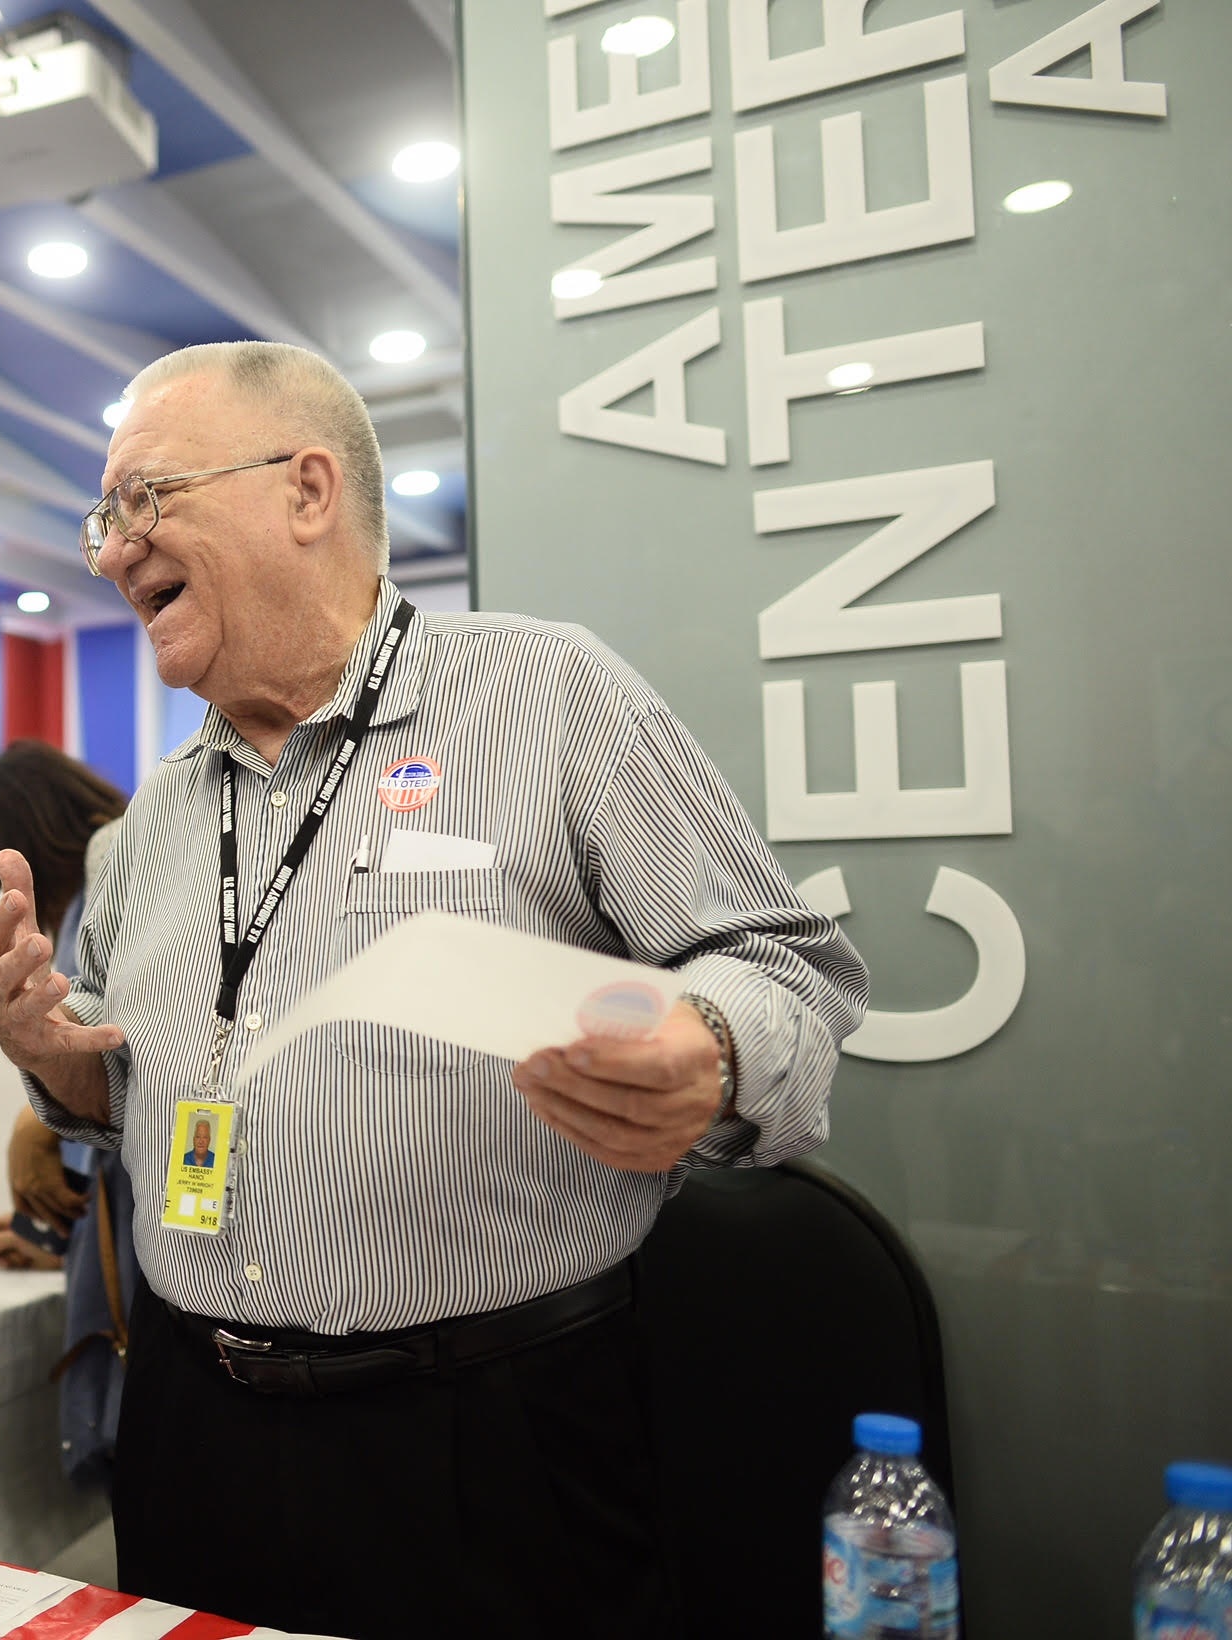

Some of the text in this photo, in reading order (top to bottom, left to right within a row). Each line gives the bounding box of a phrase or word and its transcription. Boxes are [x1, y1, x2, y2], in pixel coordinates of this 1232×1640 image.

[989, 0, 1166, 117] A
[546, 0, 726, 467] AME
[729, 0, 1026, 1062] CENTER
[312, 799, 328, 817] U.S.
[320, 762, 346, 801] EMBASSY
[223, 876, 235, 889] U.S.
[223, 888, 236, 922] EMBASSY
[254, 888, 281, 929] EMBASSY
[247, 926, 263, 945] U.S.
[200, 1215, 218, 1226] 9/18
